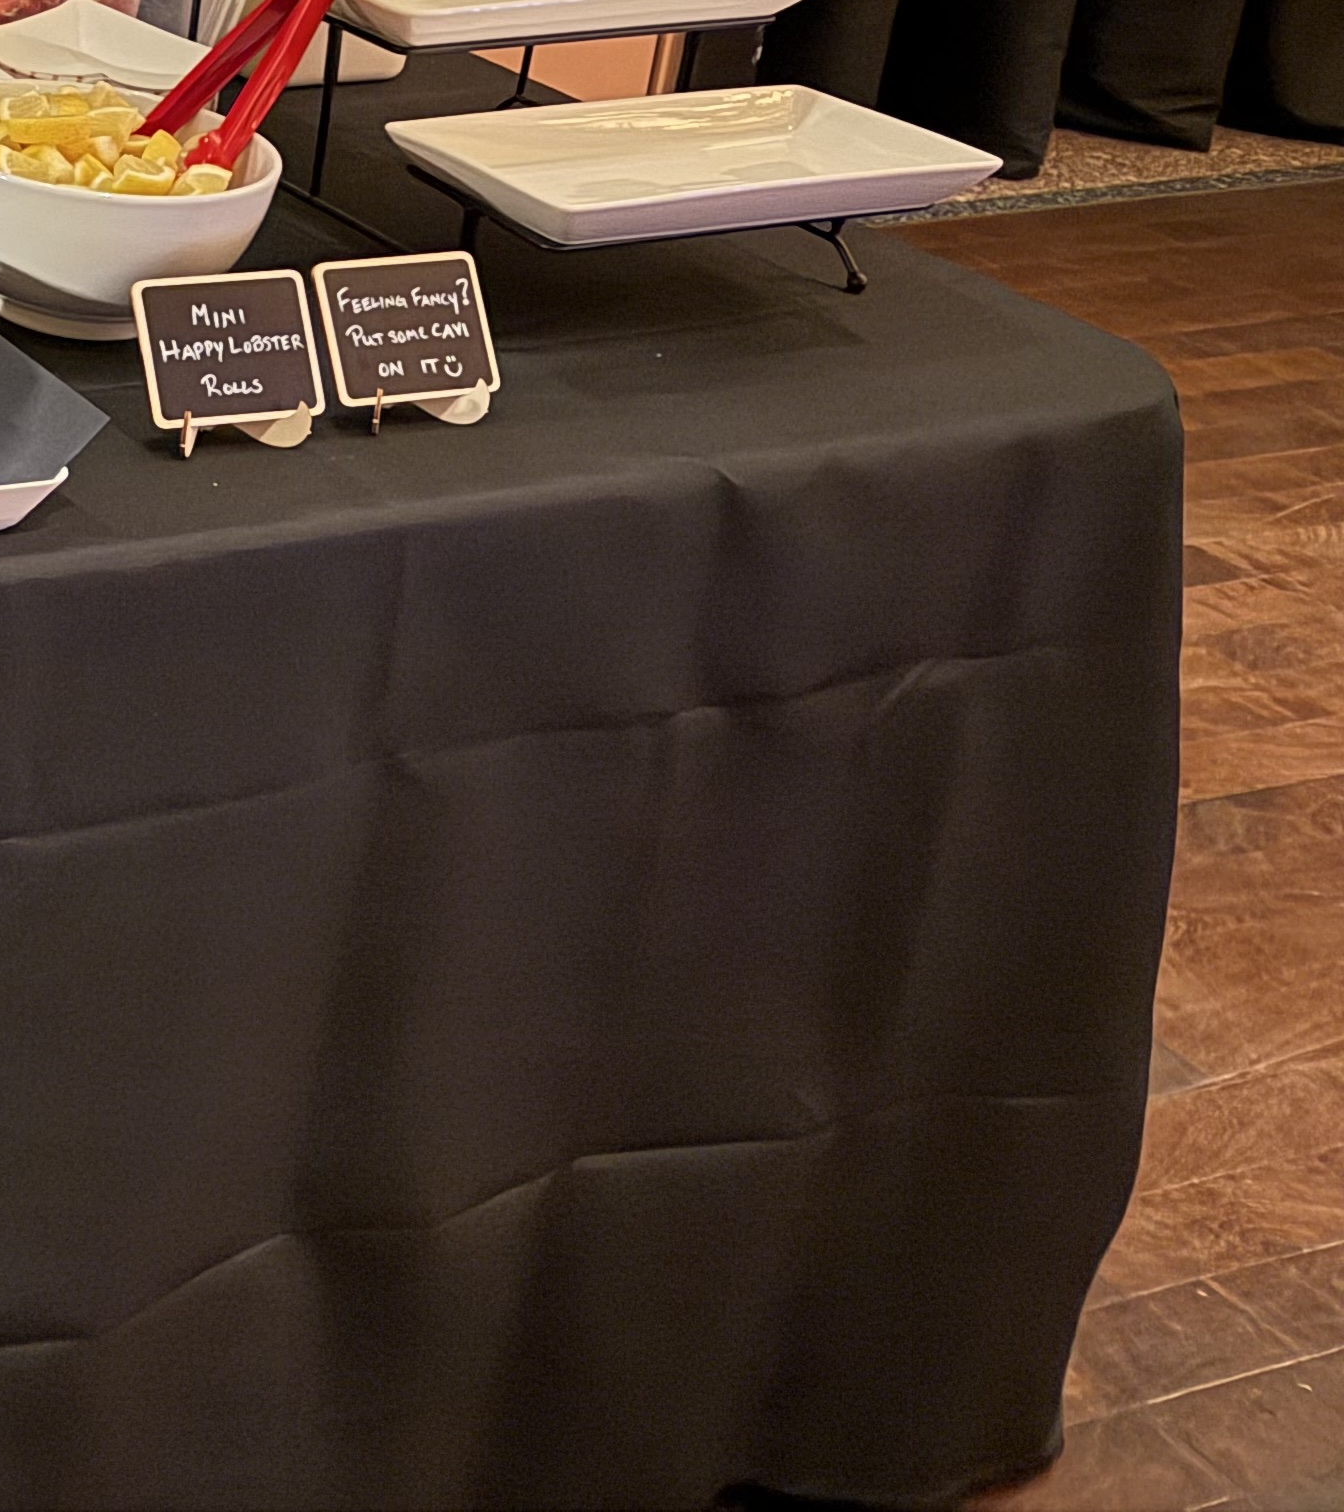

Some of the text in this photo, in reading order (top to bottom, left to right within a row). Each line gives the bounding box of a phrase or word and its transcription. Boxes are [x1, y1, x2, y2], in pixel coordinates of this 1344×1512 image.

[336, 277, 470, 315] FEELING FANCY?
[191, 303, 246, 329] MINI
[345, 321, 470, 348] PUT SOME CAVI
[159, 333, 305, 363] HAPPY LOBSTER
[378, 358, 440, 378] ON IT
[200, 373, 264, 398] ROLLS
